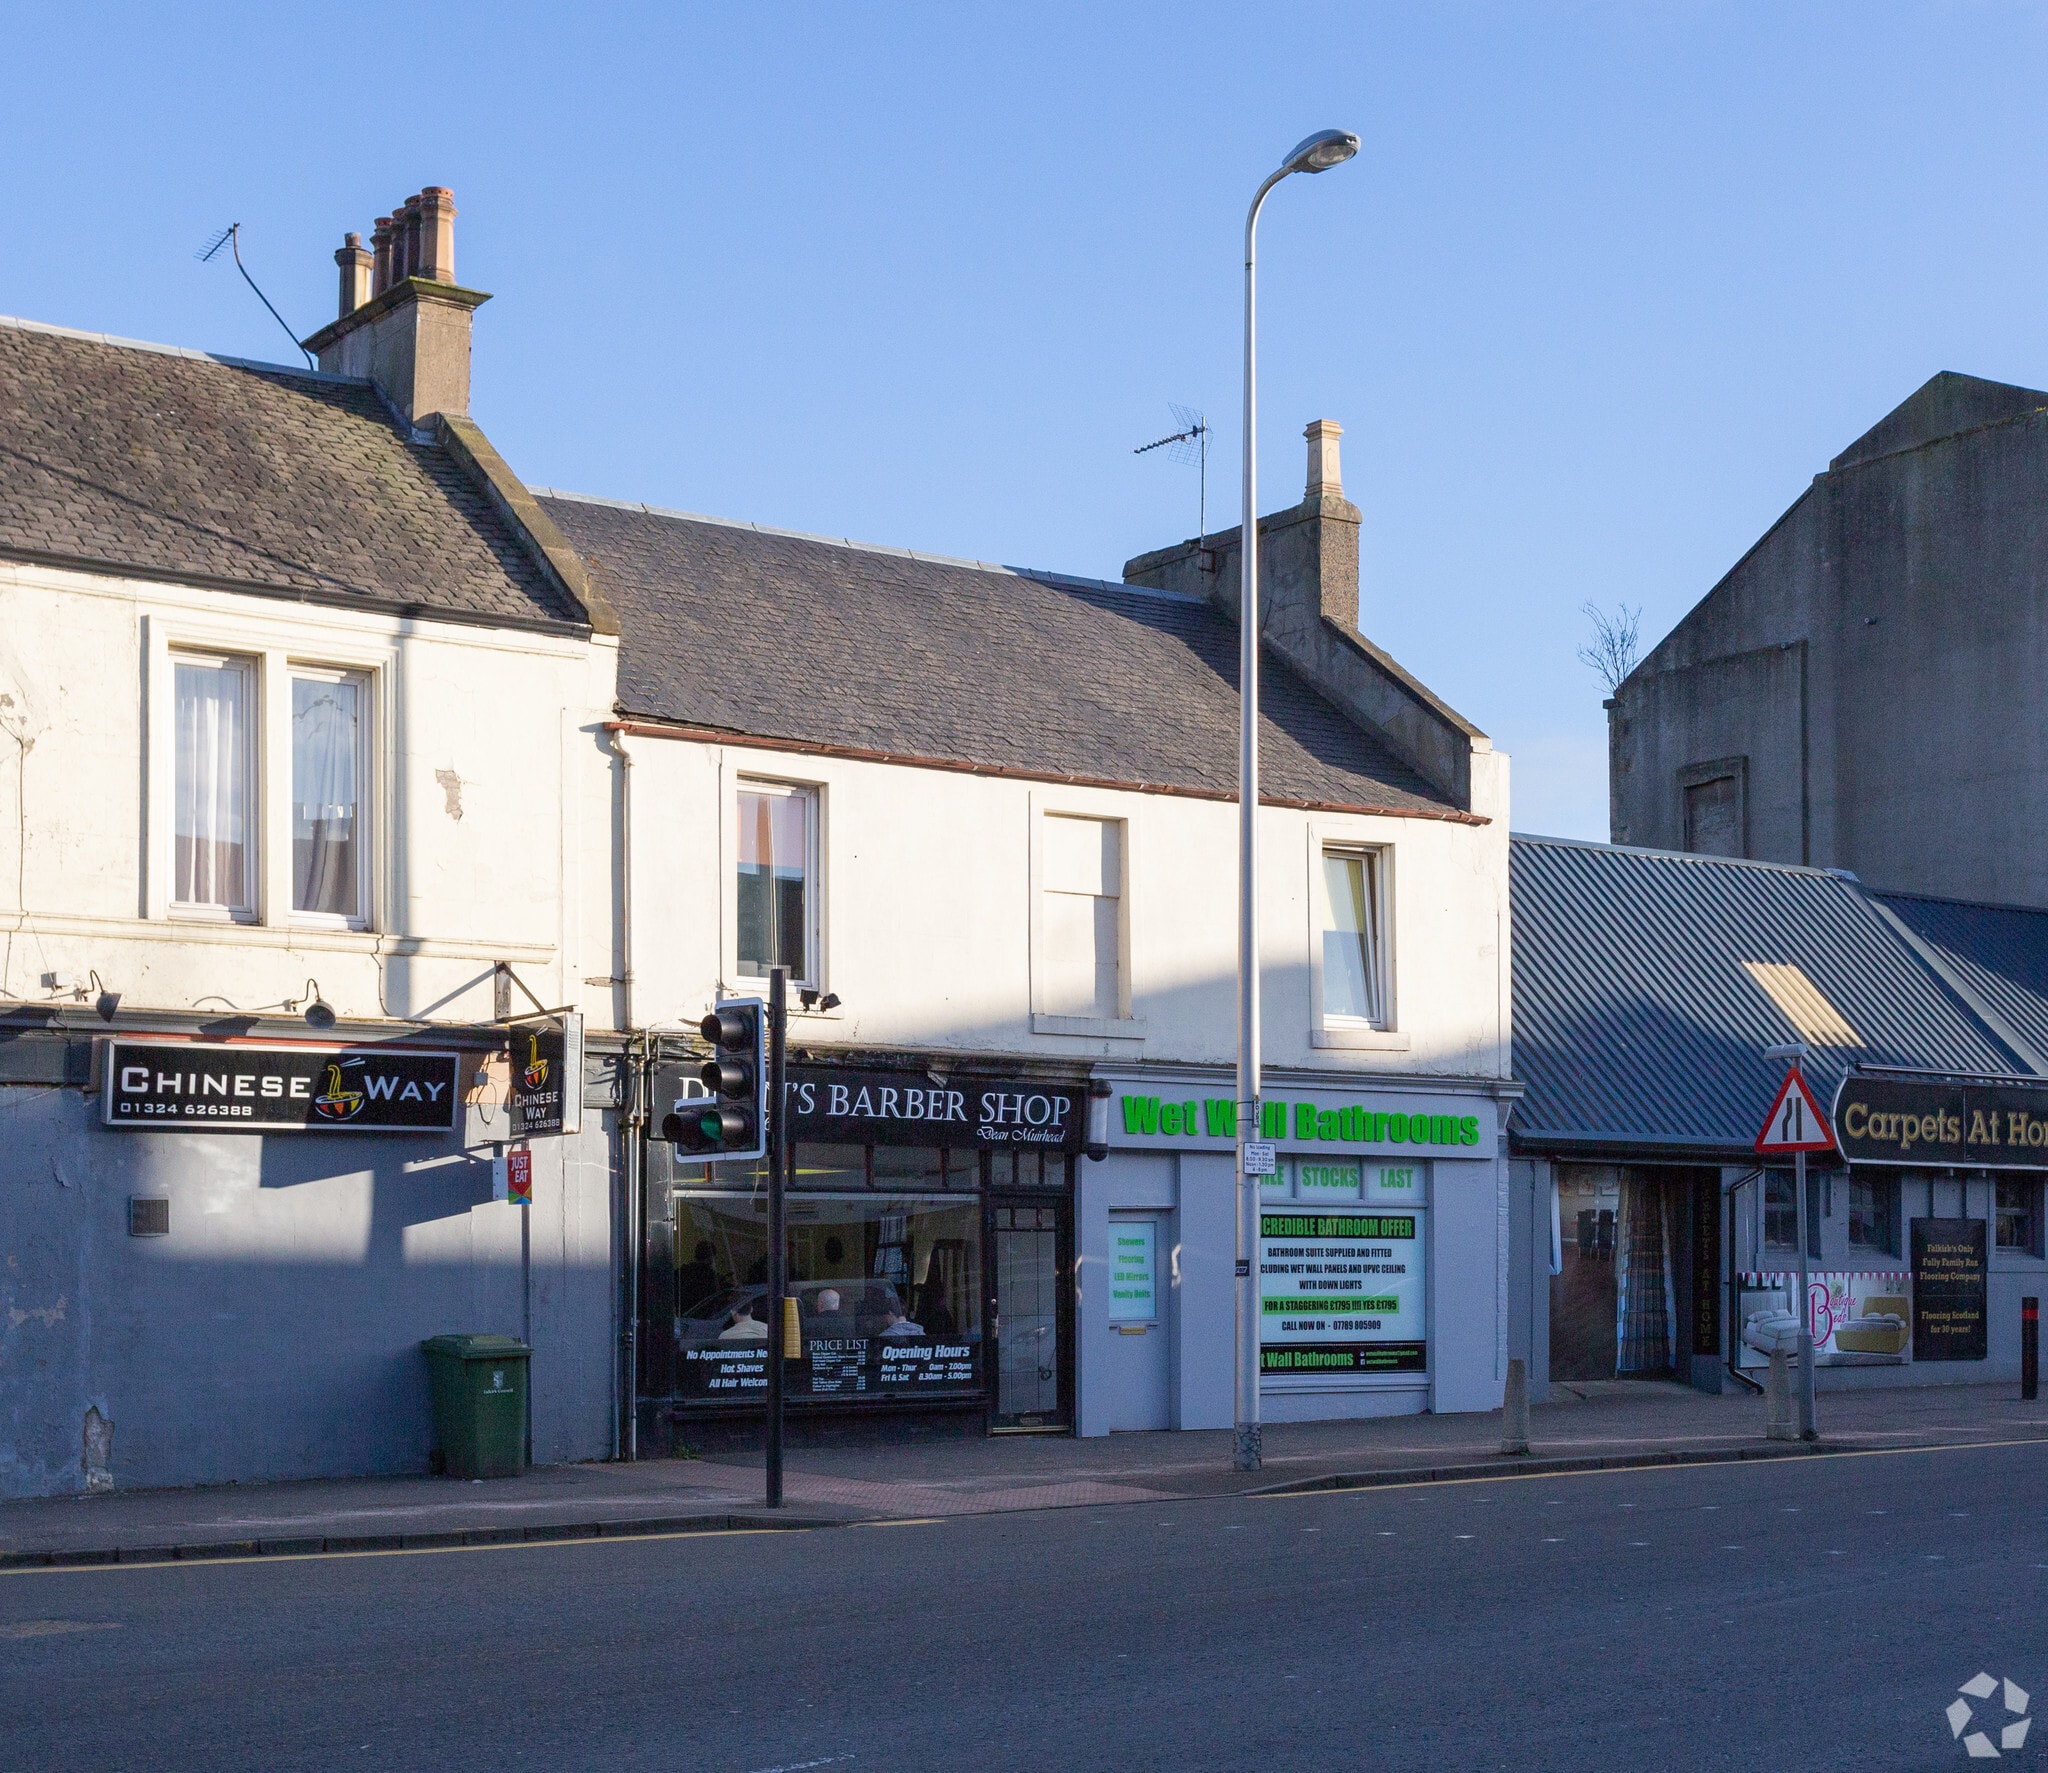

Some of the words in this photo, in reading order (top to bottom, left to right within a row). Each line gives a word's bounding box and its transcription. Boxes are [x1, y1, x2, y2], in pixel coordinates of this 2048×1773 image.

[121, 1066, 311, 1098] CHINESE
[364, 1074, 446, 1101] WAY
[515, 1091, 558, 1107] CHINESE
[826, 1084, 968, 1122] BARBER
[980, 1092, 1070, 1126] SHOP
[120, 1102, 178, 1113] 01324
[185, 1103, 252, 1116] 626388
[526, 1107, 546, 1120] WAY
[512, 1123, 533, 1131] 01324
[535, 1118, 560, 1129] 626388
[1122, 1095, 1198, 1135] Wet
[1206, 1098, 1287, 1139] Wll
[1296, 1102, 1480, 1145] Bathrooms
[1845, 1102, 1961, 1149] Carpets
[1968, 1109, 2000, 1145] At
[2008, 1111, 2048, 1147] Ho
[977, 1126, 1009, 1141] Dean
[1012, 1128, 1065, 1143] Muirhead
[511, 1156, 528, 1170] JUST
[515, 1170, 528, 1183] EAT
[1302, 1166, 1358, 1188] STOCKS
[1380, 1168, 1413, 1188] LAST
[1318, 1218, 1378, 1236] BATHROOM
[1380, 1219, 1412, 1236] OFFER
[1268, 1248, 1304, 1258] BATHROOM
[1306, 1248, 1324, 1258] SUITE
[1325, 1248, 1355, 1258] SUPPLIED
[1356, 1248, 1370, 1258] AND
[1371, 1248, 1392, 1258] FITTED
[1290, 1264, 1305, 1274] WET
[1307, 1264, 1323, 1274] WALL
[1324, 1264, 1347, 1274] PANELS
[1348, 1264, 1362, 1274] AND
[1363, 1264, 1380, 1274] UPVC
[1381, 1264, 1405, 1274] CEILING
[1920, 1272, 1949, 1281] Flooring
[1299, 1280, 1317, 1290] WITH
[1318, 1280, 1338, 1290] DOWN
[1339, 1280, 1362, 1290] LIGHTS
[1264, 1301, 1278, 1311] FOR
[1279, 1301, 1284, 1311] A
[1286, 1300, 1328, 1311] STAGGERING
[1363, 1300, 1375, 1310] YES
[1376, 1300, 1397, 1310] £1795
[1922, 1311, 1951, 1321] Flooring
[1282, 1321, 1297, 1331] CALL
[1299, 1320, 1314, 1331] NOW
[1316, 1320, 1325, 1330] ON
[810, 1340, 842, 1350] PRICE
[846, 1339, 869, 1350] LIST
[686, 1350, 698, 1360] No
[699, 1350, 755, 1361] Appointments
[882, 1345, 933, 1361] Opening
[935, 1345, 970, 1358] Hours
[1266, 1352, 1292, 1367] Wall
[1294, 1352, 1354, 1367] Bathrooms
[720, 1364, 735, 1373] Hot
[736, 1364, 764, 1373] Shaves
[709, 1378, 721, 1388] All
[721, 1378, 738, 1387] Hair
